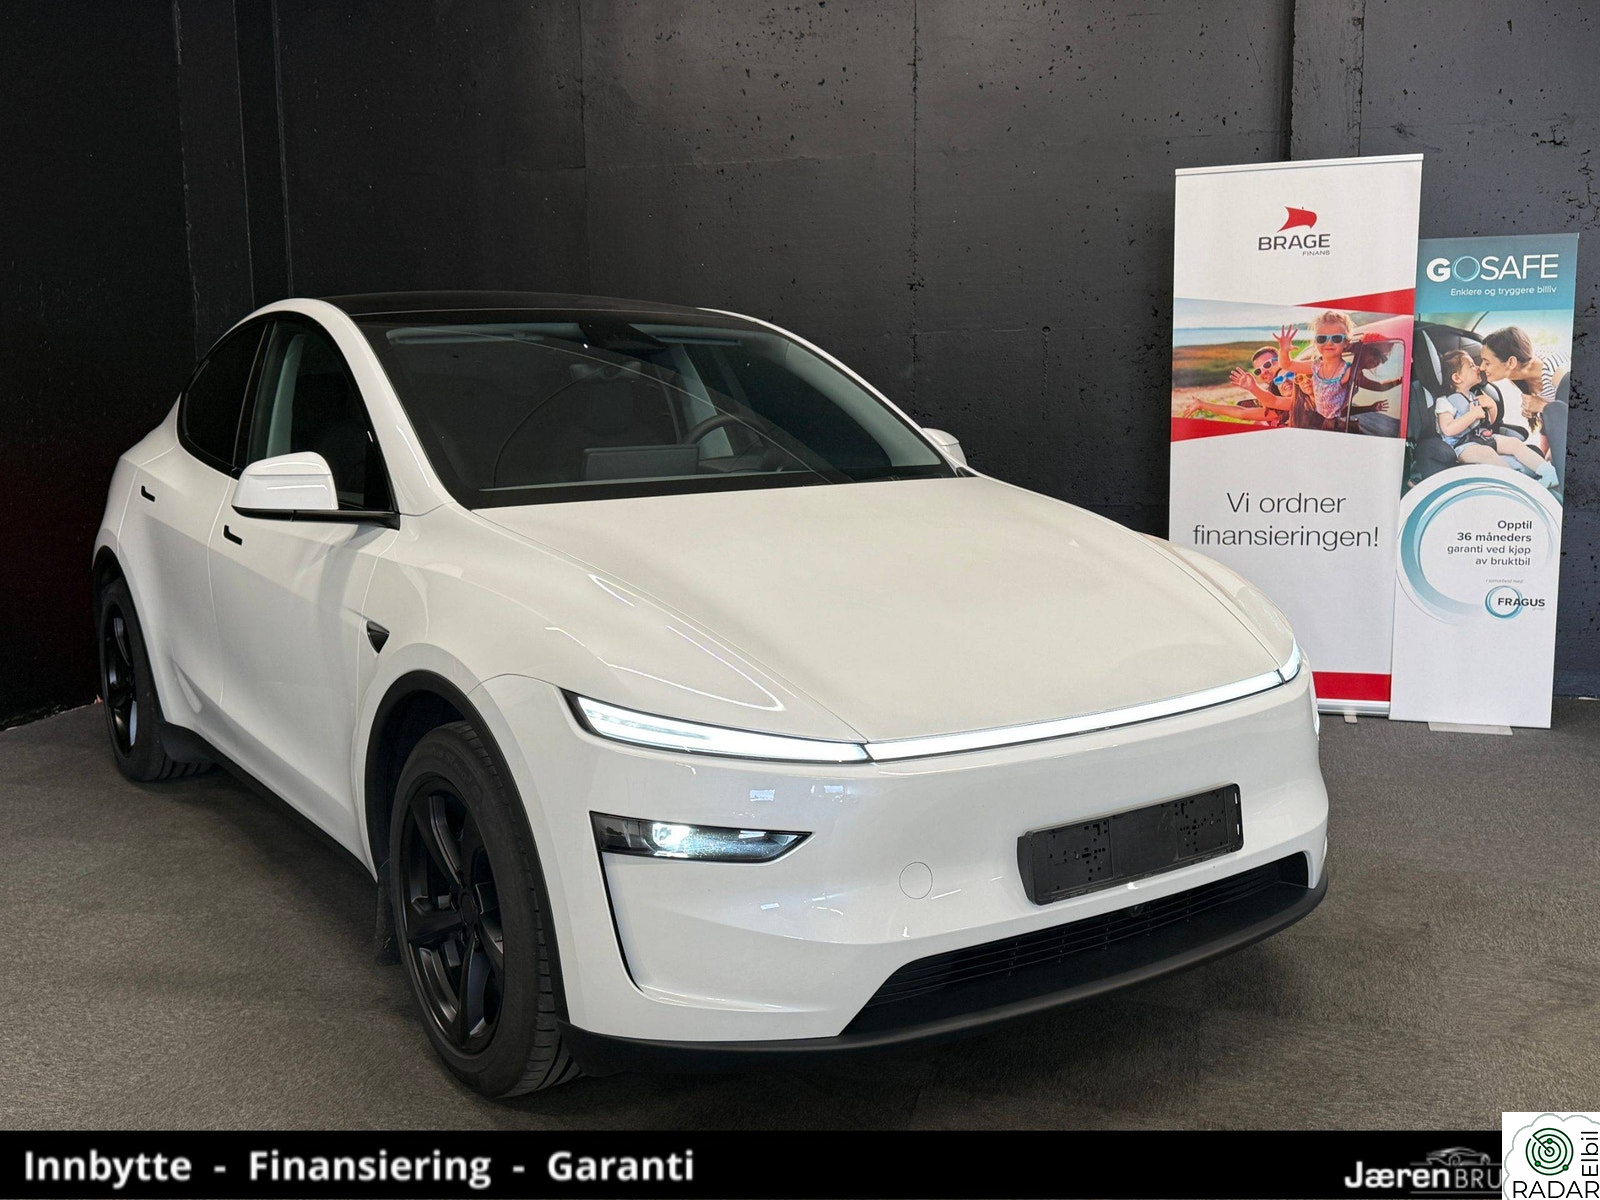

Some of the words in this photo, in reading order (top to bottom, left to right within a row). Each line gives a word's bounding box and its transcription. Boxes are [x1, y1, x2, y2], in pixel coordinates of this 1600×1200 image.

[1258, 234, 1331, 251] BRAGE
[1426, 254, 1559, 282] GOSAFE
[1450, 288, 1482, 296] Enklere
[1484, 288, 1496, 296] og
[1498, 286, 1535, 295] tryggere
[1536, 285, 1557, 293] billiv
[1227, 492, 1249, 513] Vi
[1259, 492, 1346, 513] ordner
[1497, 520, 1532, 531] Opptil
[1193, 524, 1379, 552] finansieringen!
[1457, 532, 1472, 541] 36
[1475, 532, 1532, 542] måneders
[1447, 545, 1483, 554] garanti
[1486, 545, 1505, 553] ved
[1508, 545, 1531, 556] kjøp
[1490, 557, 1531, 566] bruktbil
[1497, 597, 1546, 607] FRAGUS
